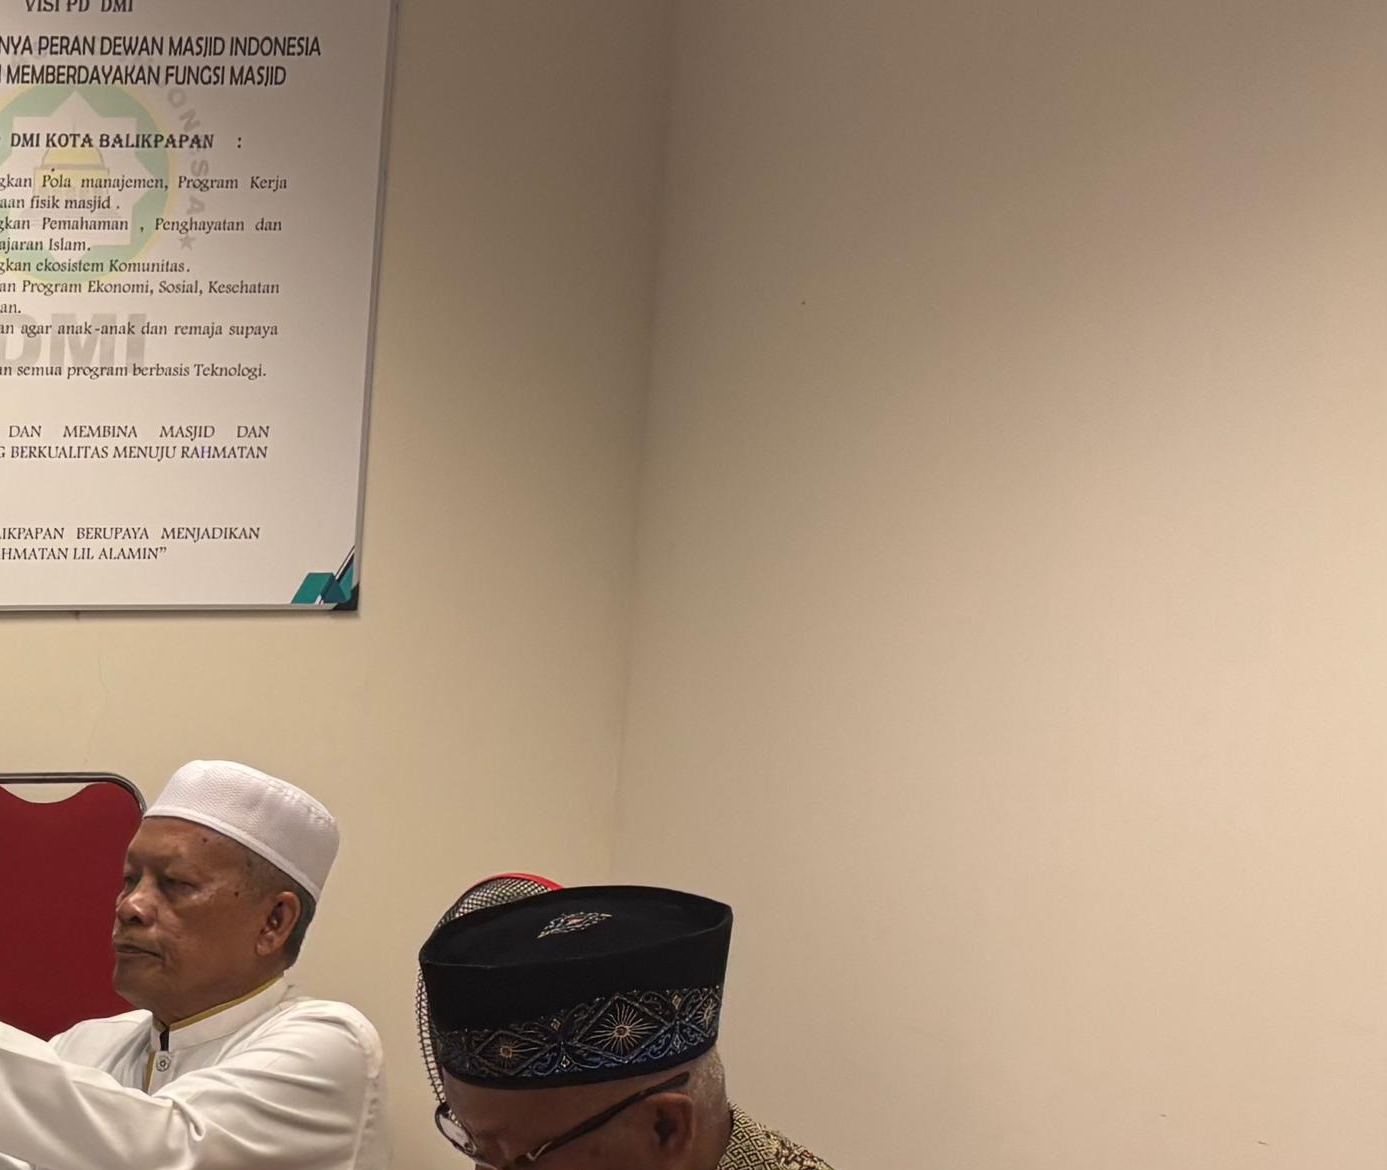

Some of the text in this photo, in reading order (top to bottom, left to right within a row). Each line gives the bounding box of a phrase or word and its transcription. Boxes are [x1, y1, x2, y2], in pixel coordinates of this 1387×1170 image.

[39, 36, 94, 56] PERAN
[101, 36, 162, 56] DEWAN
[169, 36, 225, 58] MASJID
[230, 38, 321, 57] INDONESIA
[7, 65, 159, 85] MEMBERDAYAKAN
[165, 66, 225, 86] FUNGSI
[230, 66, 286, 86] MASJID
[11, 133, 40, 147] DMI
[46, 133, 93, 148] KOTA
[99, 134, 213, 150] BALIKPAPAN
[43, 173, 71, 188] Pola
[81, 175, 169, 192] manajemen,
[178, 175, 238, 192] Program
[250, 176, 287, 192] Kerja
[31, 194, 59, 210] fisik
[65, 196, 111, 212] masjid
[42, 217, 127, 231] Pemahaman
[155, 217, 245, 234] Penghayatan
[255, 218, 282, 232] dan
[0, 238, 43, 254] ajaran
[48, 236, 91, 252] Islam.
[36, 258, 105, 274] ekosistem
[109, 258, 190, 274] Komunitas.
[22, 280, 83, 297] Program
[87, 280, 154, 296] Ekonomi,
[159, 280, 203, 296] Sosial,
[208, 280, 279, 294] Kesehatan
[21, 324, 52, 338] agar
[57, 322, 135, 336] anak-anak
[141, 322, 167, 336] dan
[173, 322, 223, 338] remaja
[229, 324, 278, 338] supaya
[17, 366, 62, 378] semua
[67, 366, 128, 380] program
[133, 363, 189, 378] berbasis
[194, 364, 266, 380] Teknologi.
[9, 425, 41, 438] DAN
[63, 425, 138, 438] MEMBINA
[159, 425, 215, 440] MASJID
[237, 425, 269, 438] DAN
[11, 446, 109, 460] BERKUALITAS
[113, 446, 176, 461] MENUJU
[181, 446, 267, 460] RAHMATAN
[77, 528, 149, 540] BERUPAYA
[161, 528, 260, 542] MENJADIKAN
[73, 548, 94, 561] LIL
[99, 546, 167, 561] ALAMIN”
